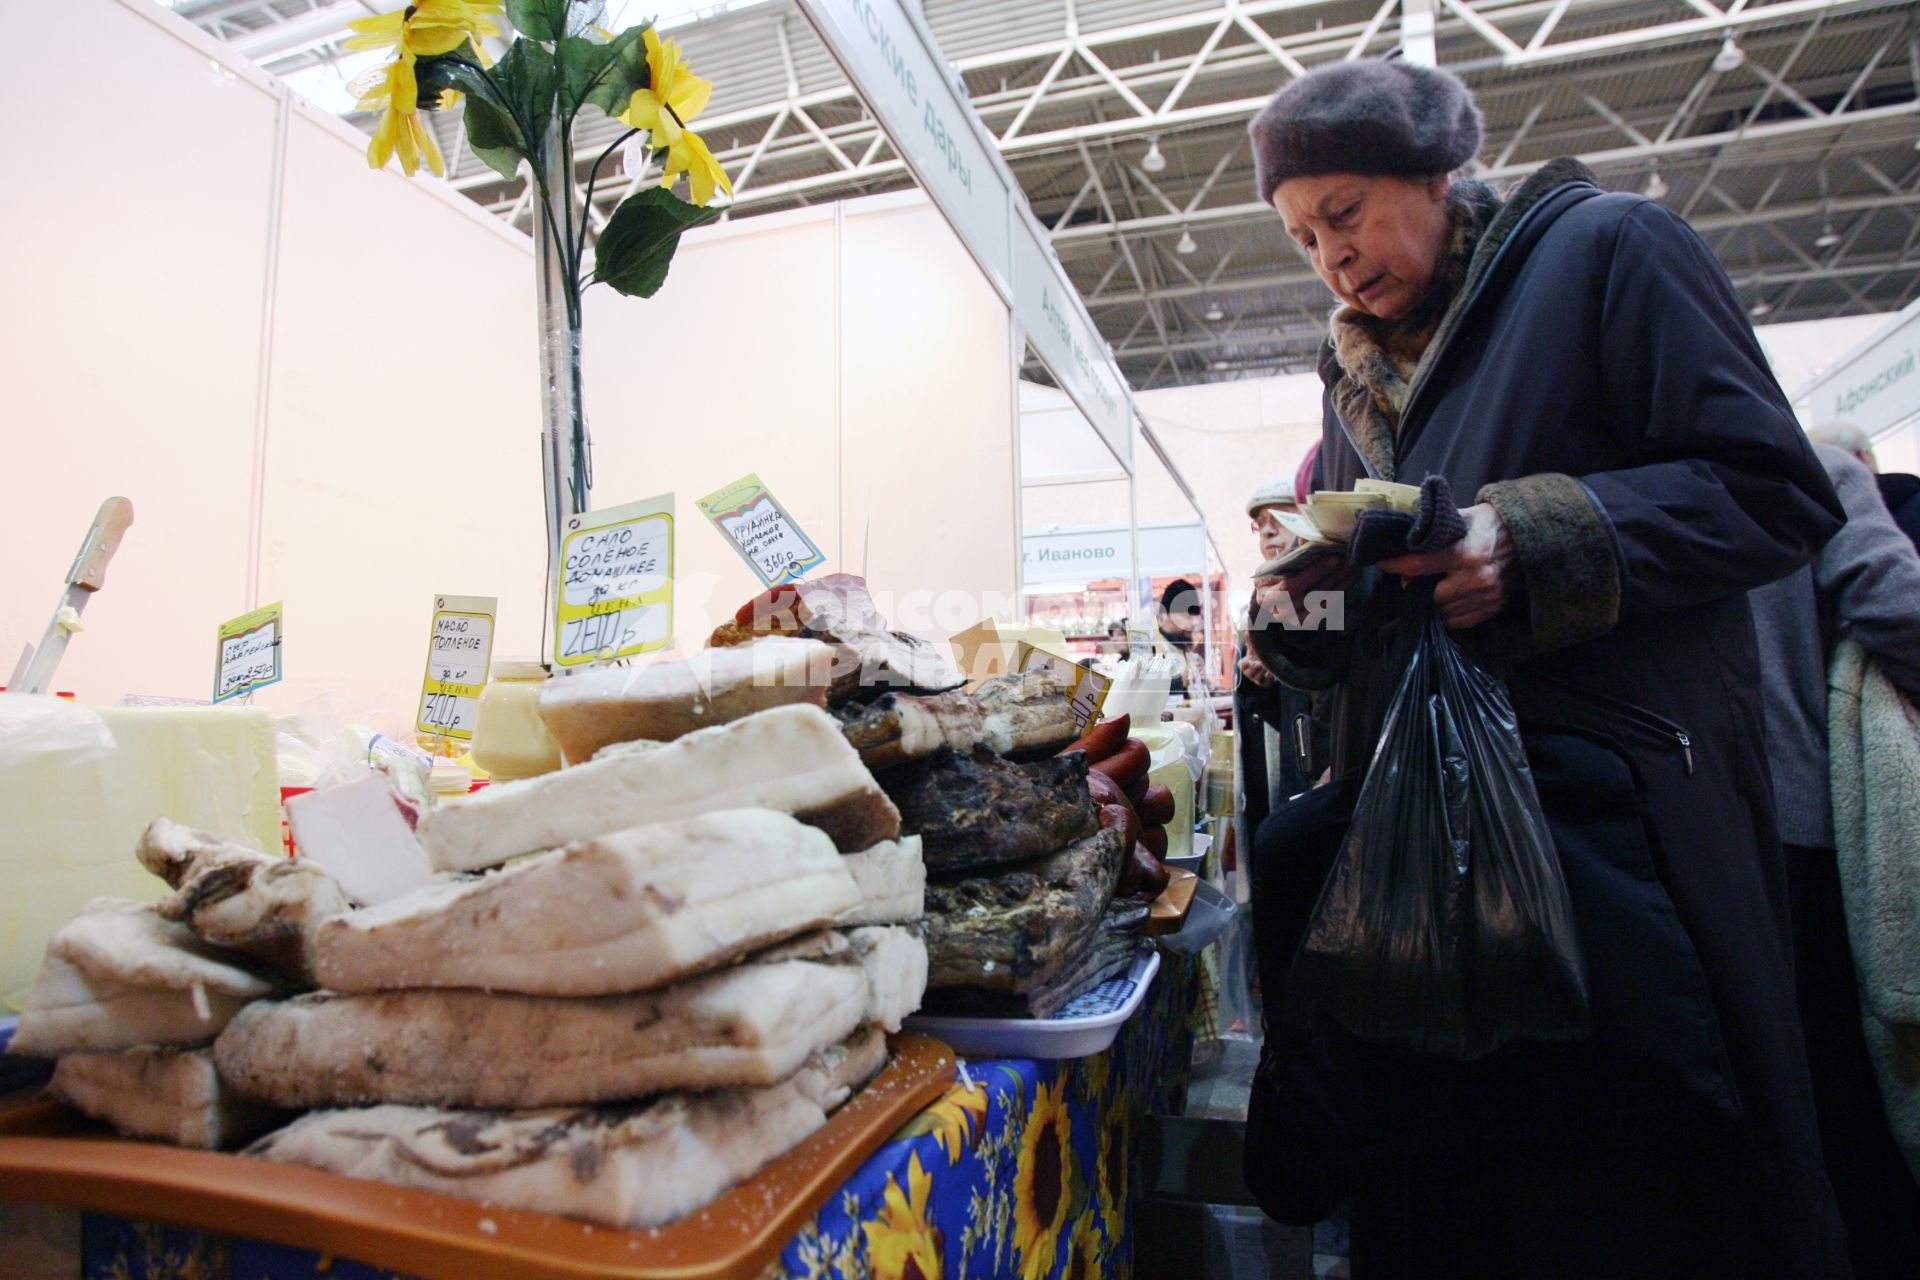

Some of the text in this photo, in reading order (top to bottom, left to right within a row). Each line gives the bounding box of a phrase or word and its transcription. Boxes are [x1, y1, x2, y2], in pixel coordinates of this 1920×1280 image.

[924, 98, 972, 195] дары
[581, 529, 633, 553] САЛО
[1038, 545, 1116, 562] Иваново
[564, 558, 656, 586] ДОМАШНЕЕ
[435, 619, 469, 635] МАСЛО
[432, 634, 481, 650] ТОПЛЕНОЕ
[440, 681, 470, 695] ЦЕНА
